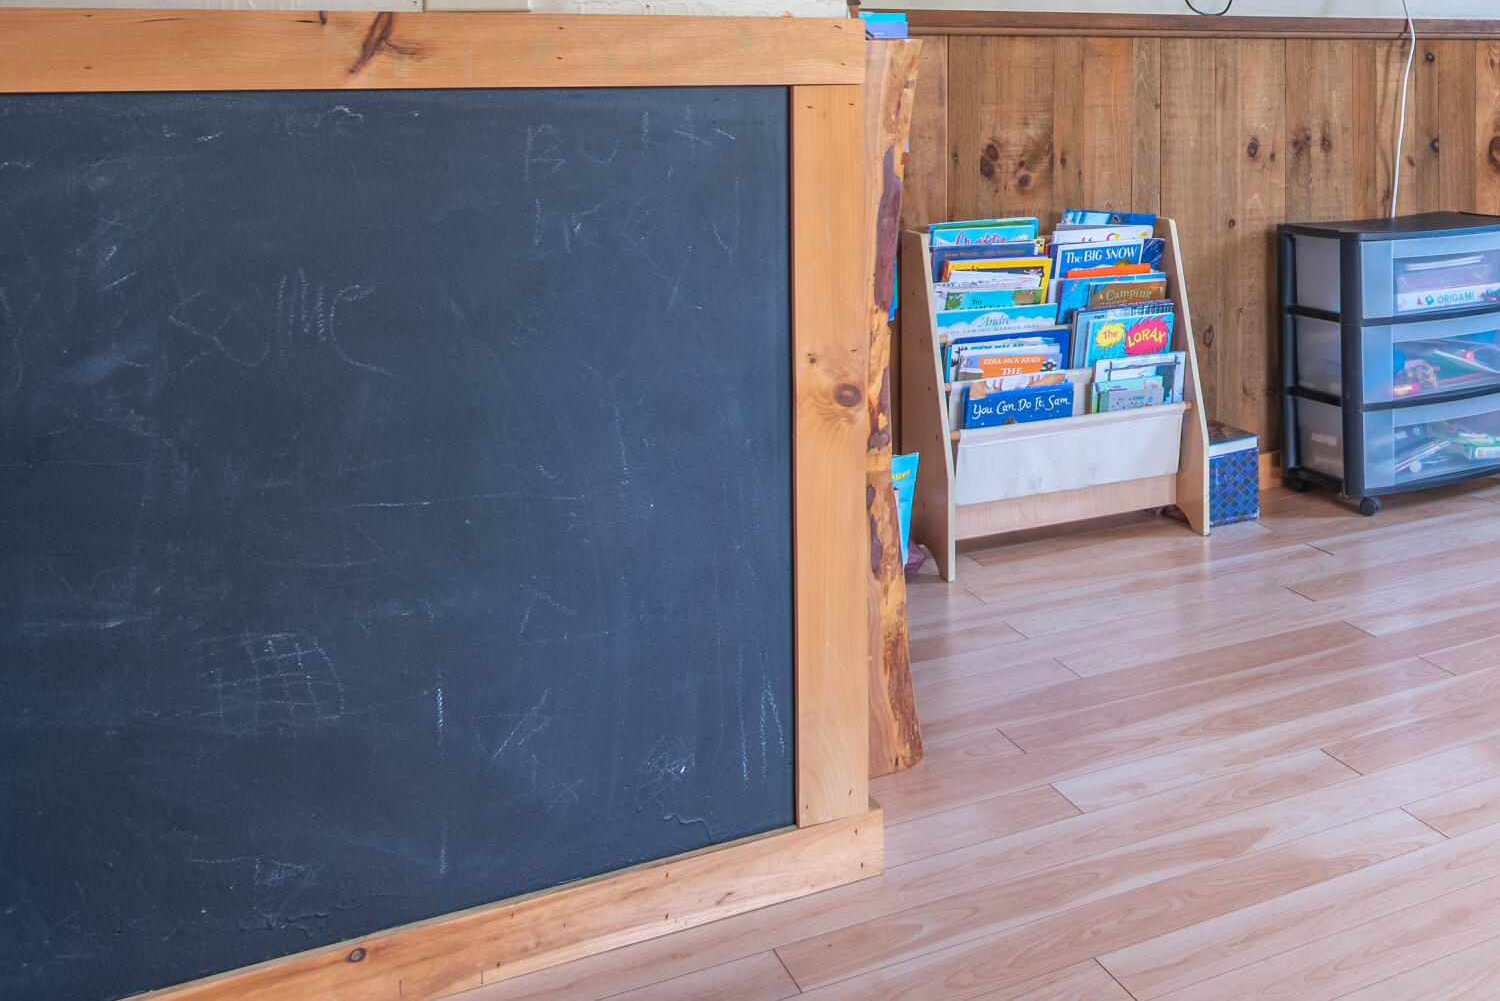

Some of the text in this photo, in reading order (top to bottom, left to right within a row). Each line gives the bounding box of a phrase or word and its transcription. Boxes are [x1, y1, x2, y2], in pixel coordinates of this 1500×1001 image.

[1065, 246, 1138, 264] The BIG SNOW
[1105, 287, 1153, 301] Camping
[1436, 290, 1475, 305] ORIGAMI
[1102, 327, 1166, 348] The LORAX
[1001, 367, 1023, 375] THE
[971, 403, 993, 420] You
[996, 400, 1016, 415] Can
[1017, 398, 1032, 412] Do
[1045, 394, 1071, 411] Sam
